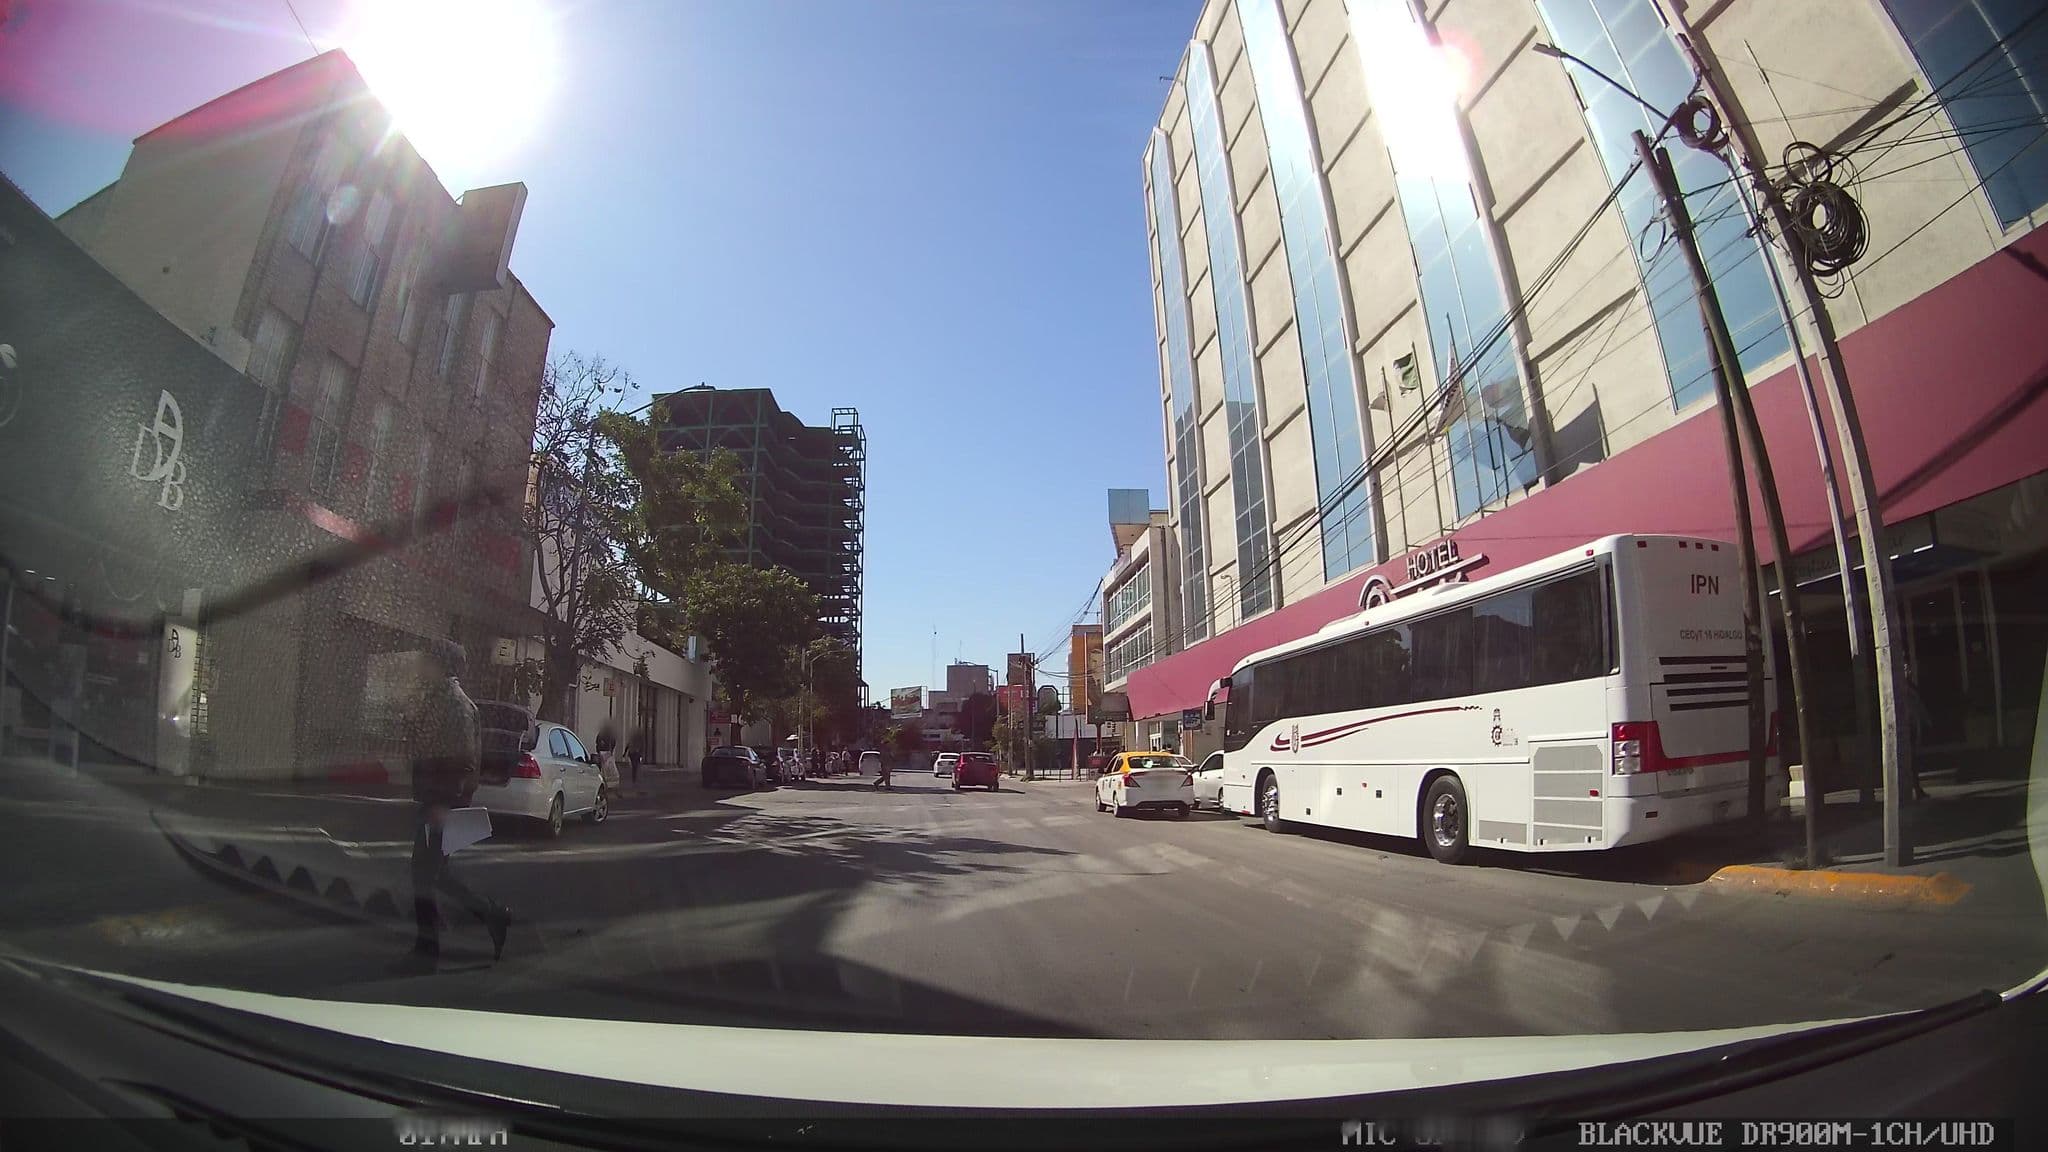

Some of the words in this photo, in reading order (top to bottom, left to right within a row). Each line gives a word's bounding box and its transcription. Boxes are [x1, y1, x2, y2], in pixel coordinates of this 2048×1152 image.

[1406, 539, 1459, 580] HOTEL
[1690, 574, 1720, 595] IPN
[1713, 630, 1743, 640] HIDALGO
